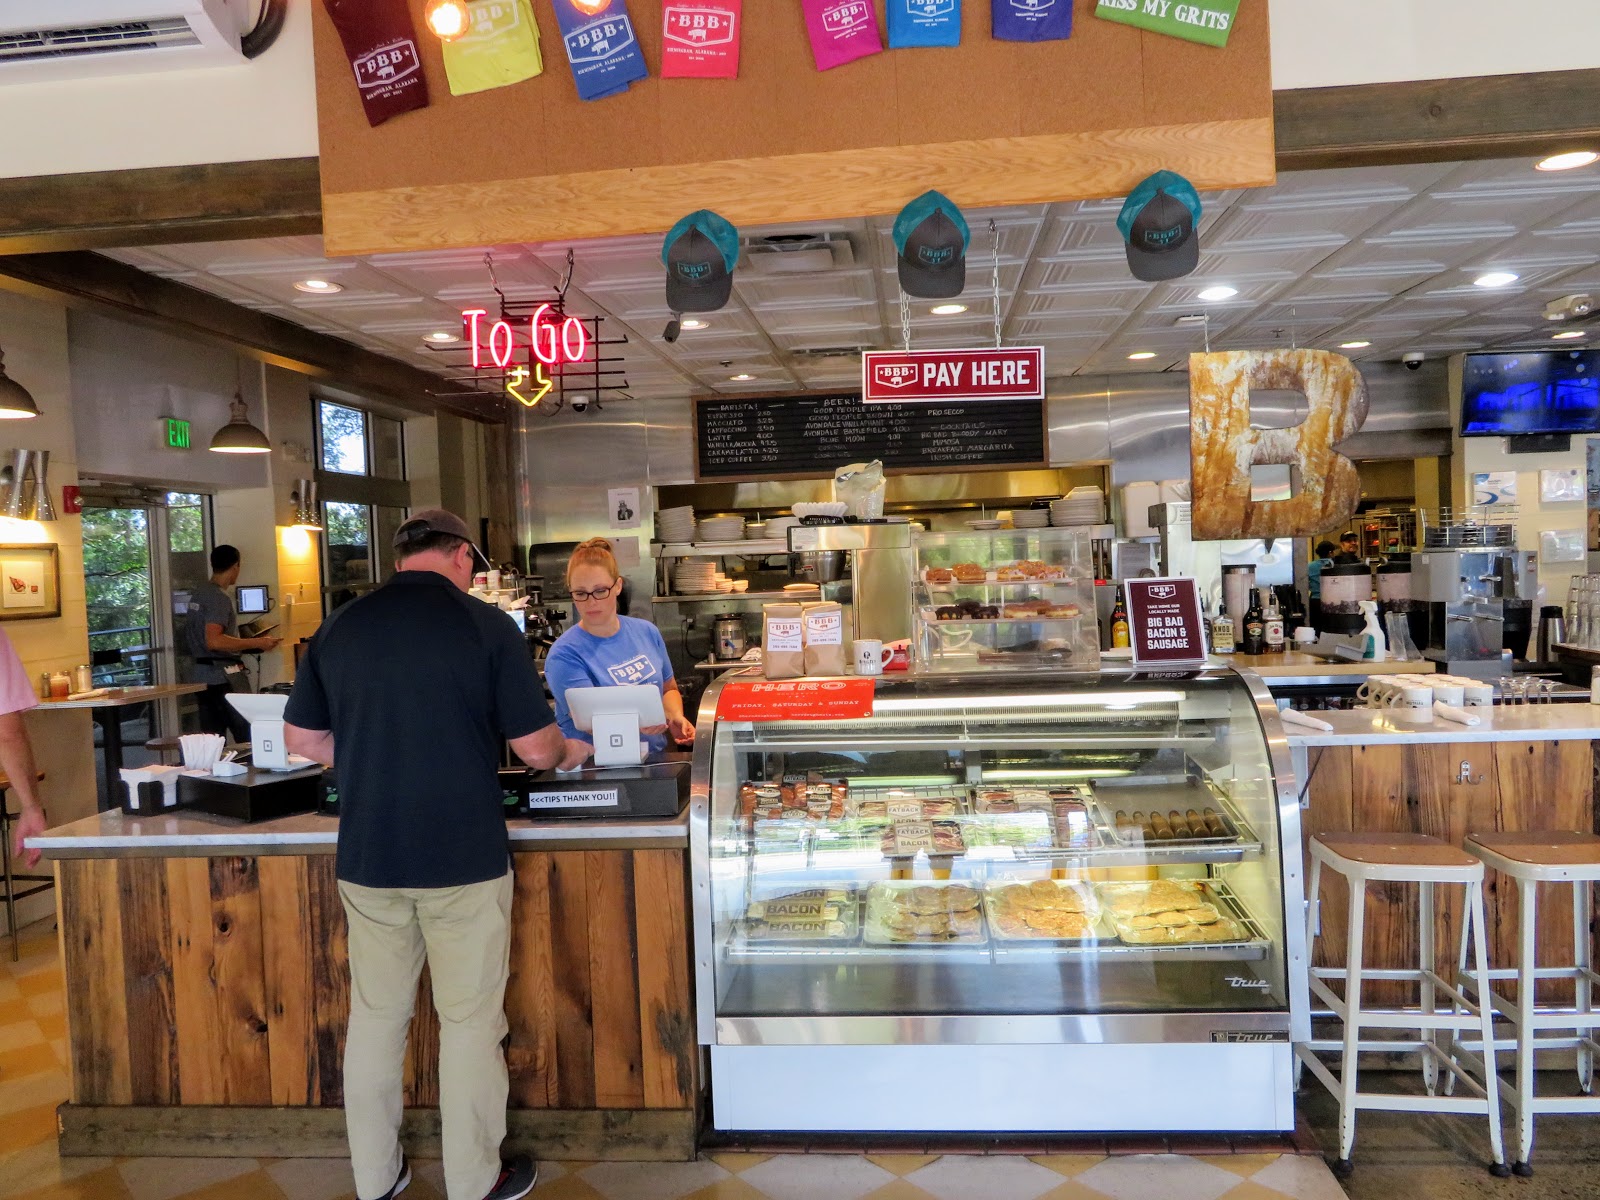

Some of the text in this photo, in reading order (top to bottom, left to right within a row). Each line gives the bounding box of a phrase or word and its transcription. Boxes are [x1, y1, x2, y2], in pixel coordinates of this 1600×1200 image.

[832, 6, 858, 21] BBB
[1098, 0, 1229, 30] SS MY GRITS
[678, 14, 719, 28] BBB
[578, 24, 617, 48] BBB
[366, 50, 402, 74] BBB
[884, 360, 1030, 388] BBB PAY HERE
[824, 398, 855, 407] BEER!
[168, 419, 190, 448] EXIT
[1147, 616, 1184, 628] BIG BAD
[1147, 628, 1187, 638] BACON &
[1147, 638, 1190, 650] SAUSAGE
[617, 662, 644, 678] BBB
[752, 682, 846, 692] HERO
[562, 794, 590, 802] THANK
[592, 792, 615, 801] YOU!!
[766, 904, 821, 914] BACON
[769, 922, 826, 932] BACON
